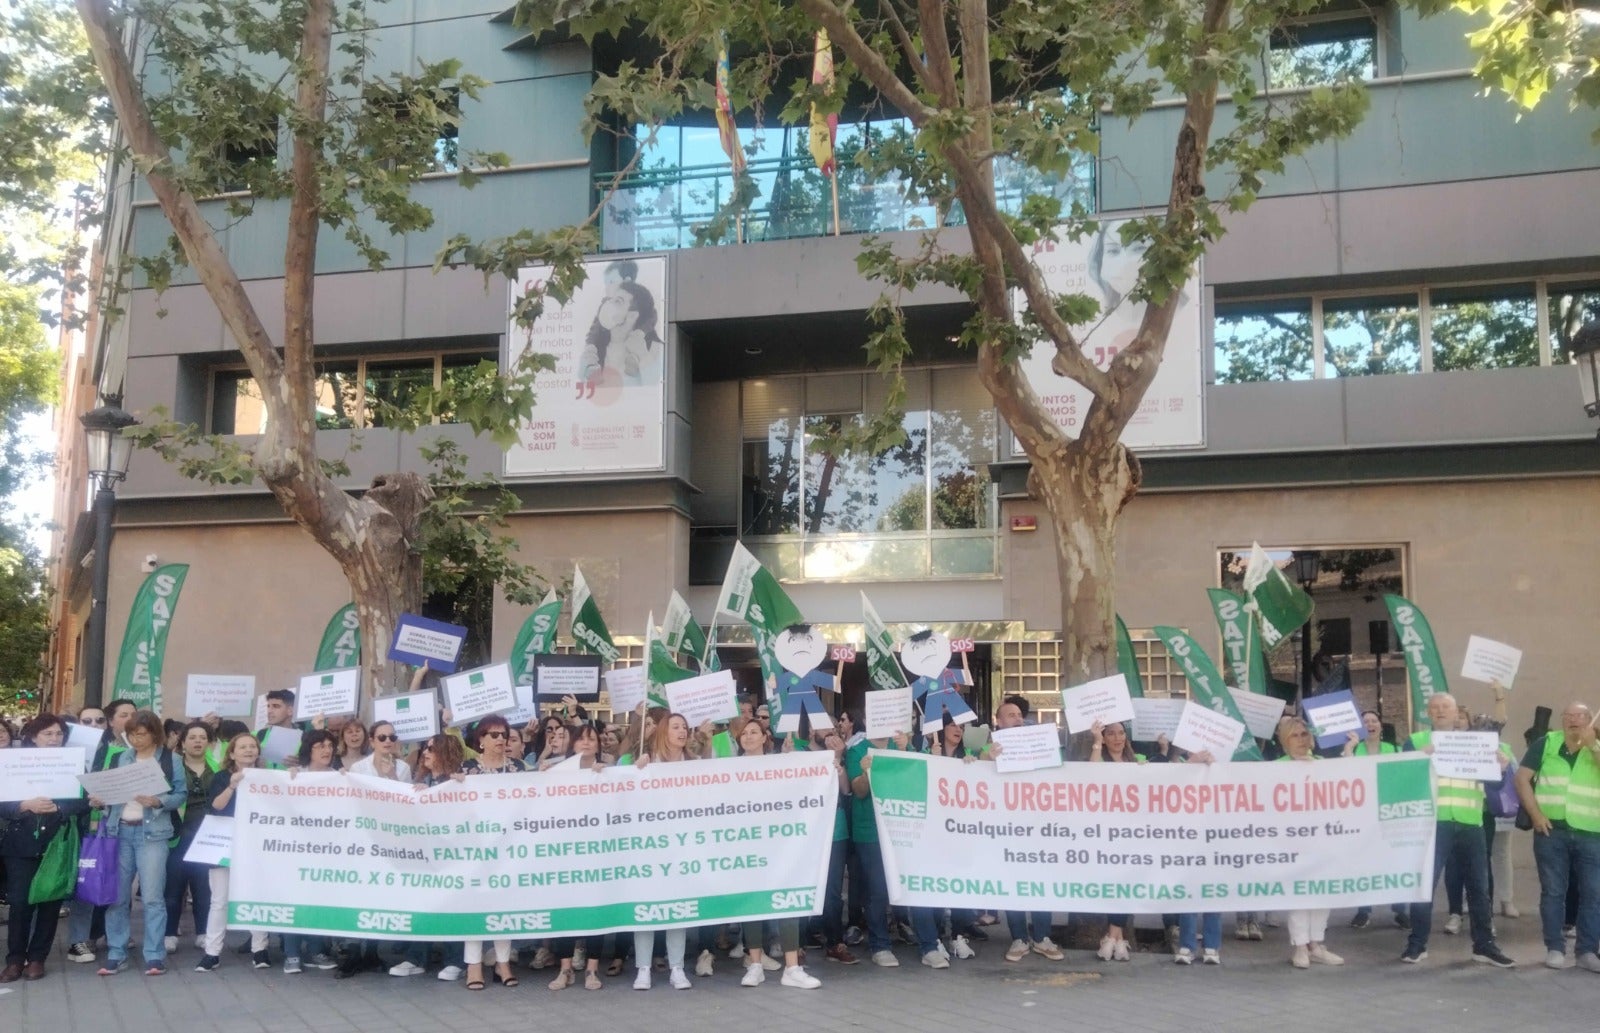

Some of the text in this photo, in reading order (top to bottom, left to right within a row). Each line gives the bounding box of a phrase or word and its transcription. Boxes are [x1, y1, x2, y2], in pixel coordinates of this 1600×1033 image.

[1061, 263, 1086, 276] que
[540, 339, 573, 347] molta
[537, 379, 571, 389] costat
[1039, 394, 1076, 405] UNTOS
[525, 421, 556, 431] JUNTS
[527, 442, 557, 451] SALUT
[533, 432, 556, 441] SOM
[573, 621, 622, 665] SATSE
[952, 639, 973, 651] SOS
[833, 648, 855, 660] SOS
[249, 783, 284, 796] S.O.S.
[287, 785, 362, 799] URGENCIAS
[365, 788, 415, 805] HOSPITAL
[419, 790, 479, 805] CLÍNICO
[497, 786, 541, 800] S.O.S.
[546, 780, 635, 797] URGENCIAS
[640, 772, 731, 791] COMUNIDAD
[735, 765, 829, 783] VALENCIANA
[938, 775, 1366, 814] S.O.S. URGENCIAS HOSPITAL CLÍNICO
[249, 795, 825, 837] Para atender 500 urgencias al día, siguiendo las recomendaciones del
[1380, 799, 1433, 820] SATSE
[945, 818, 1034, 839] Cualquier
[1040, 822, 1076, 840] día,
[1083, 823, 1100, 838] el
[1108, 824, 1198, 842] paciente
[1205, 823, 1278, 843] puedes
[1285, 825, 1318, 838] ser
[1325, 821, 1360, 836] tú...
[262, 822, 808, 863] Ministerio de Sanidad, FALTAN 10 ENFERMERAS Y 5 TCAE POR
[1004, 848, 1299, 869] hasta 80 horas para ingresar
[298, 867, 363, 885] TURNO.
[368, 871, 380, 885] X
[385, 871, 395, 886] 6
[400, 873, 465, 889] TURNOS
[488, 874, 511, 889] 60
[517, 864, 653, 888] ENFERMERAS
[658, 862, 672, 877] Y
[679, 860, 701, 875] 30
[707, 855, 768, 872] TCAEs
[1016, 880, 1046, 897] EN
[1053, 882, 1192, 900] URGENCIAS.
[1201, 883, 1229, 898] ES
[1237, 880, 1285, 897] UNA
[235, 903, 296, 924] SATSE
[357, 911, 412, 932] SATSE
[485, 912, 552, 932] SATSE
[633, 899, 699, 922] SATSE
